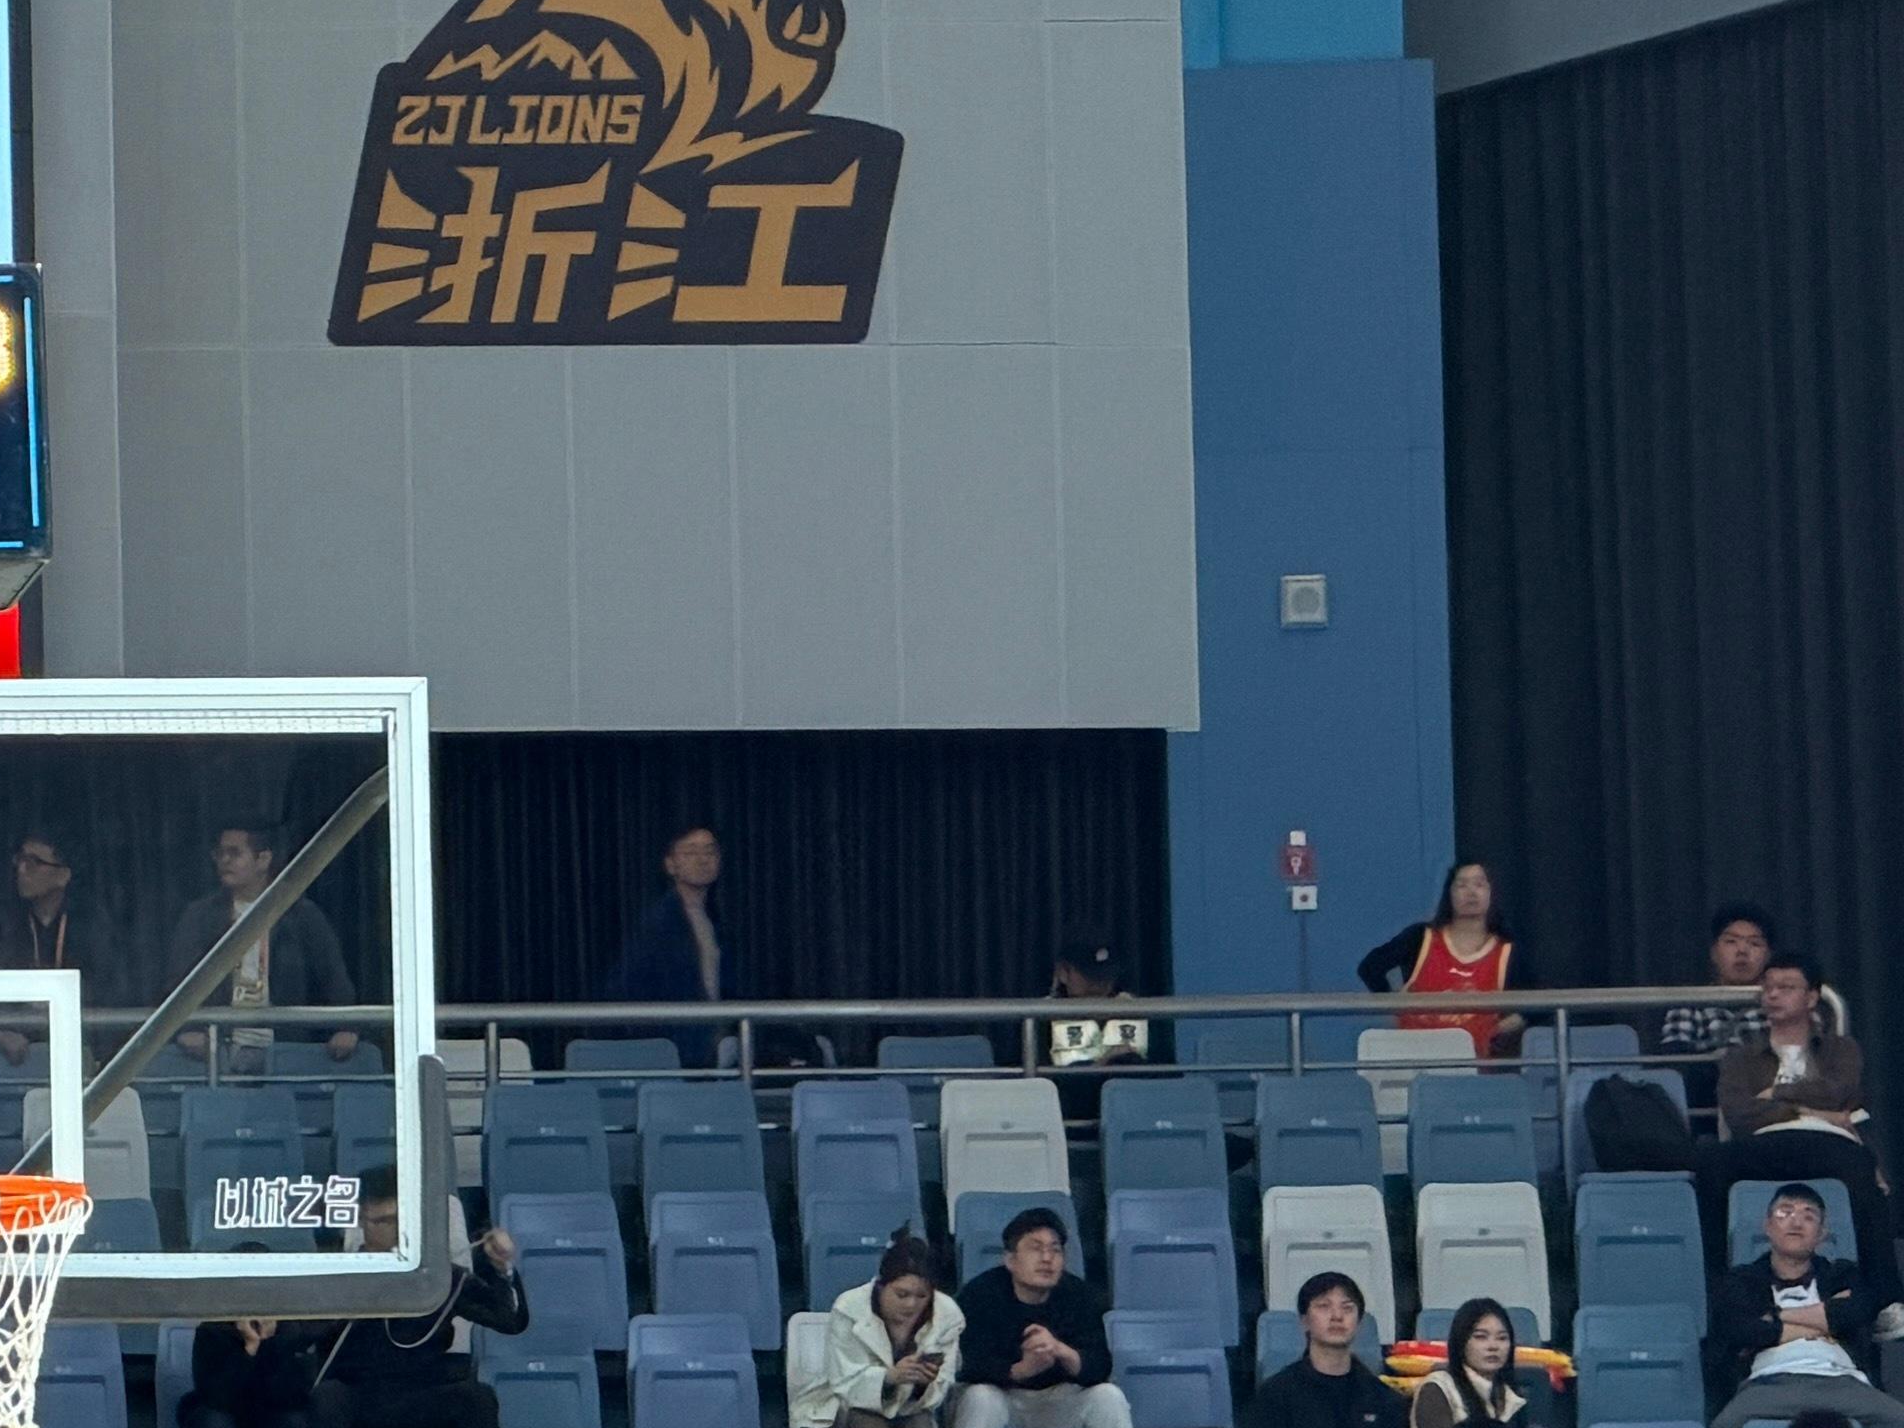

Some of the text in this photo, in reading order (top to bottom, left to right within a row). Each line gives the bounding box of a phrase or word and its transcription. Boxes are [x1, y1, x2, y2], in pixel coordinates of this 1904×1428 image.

[392, 95, 643, 145] ZJ LIONS
[360, 158, 856, 324] 浙江
[214, 1174, 360, 1230] 以城之名
